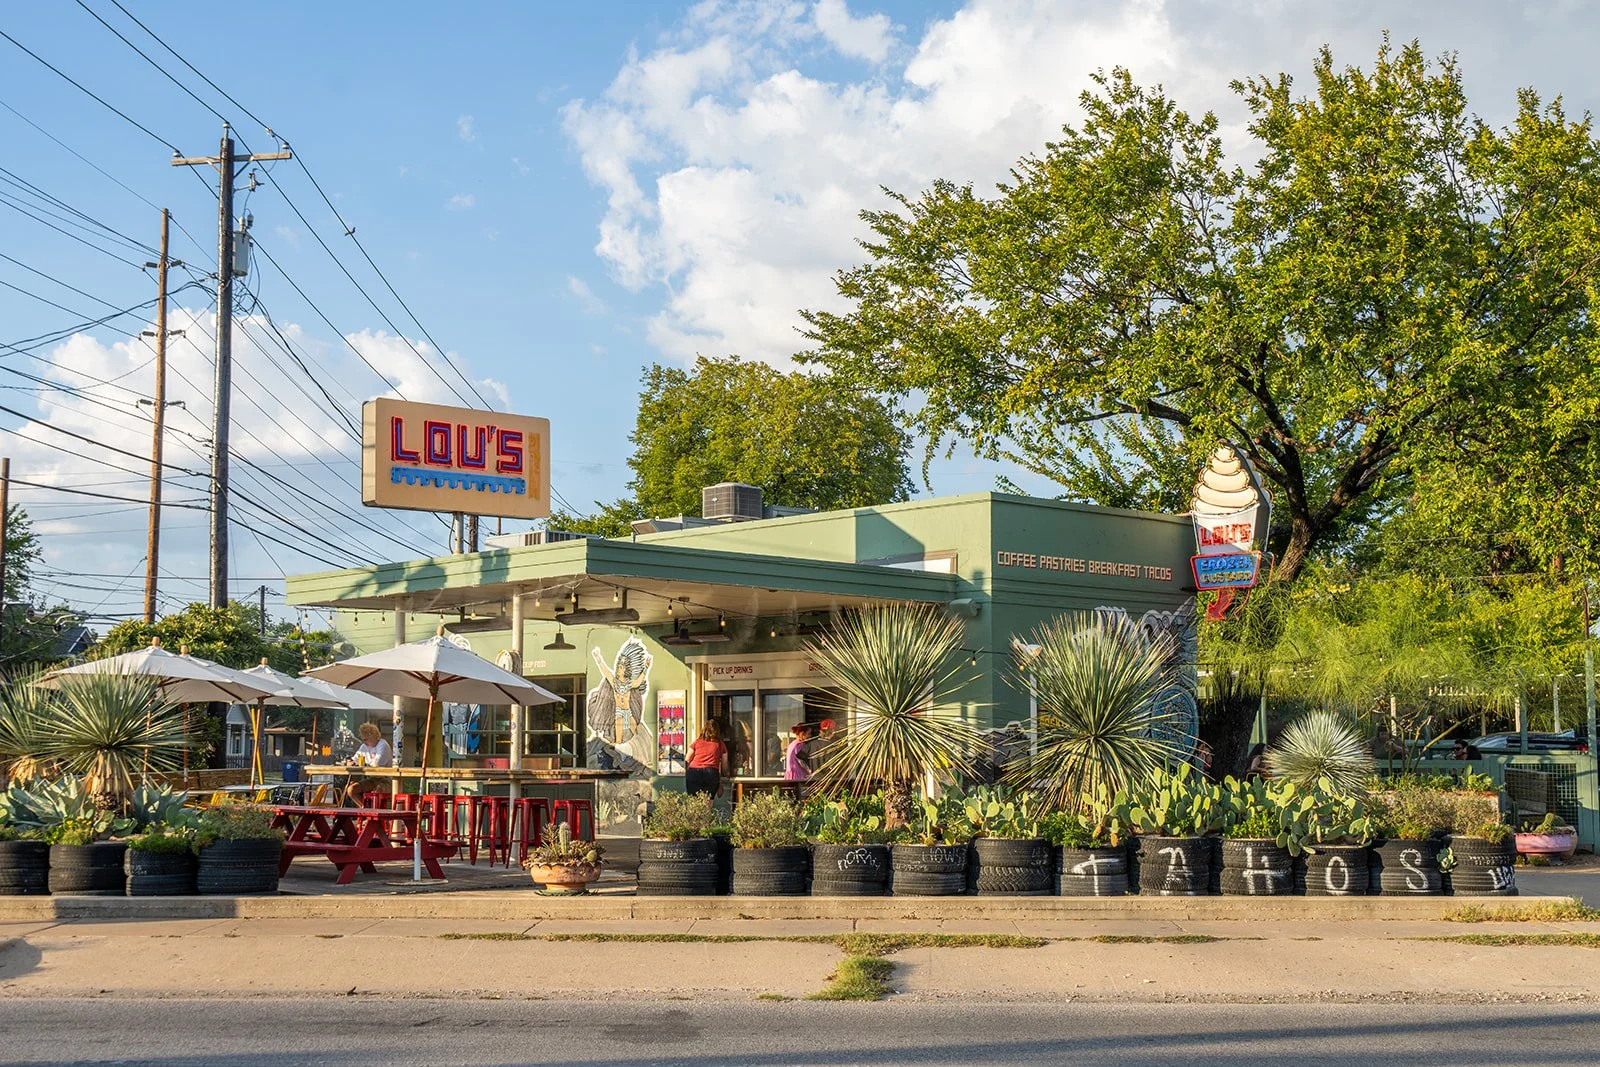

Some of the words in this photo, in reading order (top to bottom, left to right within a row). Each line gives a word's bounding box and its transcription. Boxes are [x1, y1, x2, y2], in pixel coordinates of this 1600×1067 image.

[391, 415, 524, 474] LOU'S
[1199, 523, 1252, 546] LOU'S
[997, 551, 1037, 568] COFFEE
[1039, 555, 1086, 573] PASTRIES
[1088, 560, 1142, 578] BREAKFAST
[1144, 565, 1172, 581] TACOS
[713, 666, 725, 675] PICK
[726, 666, 734, 674] UP
[734, 665, 753, 674] DRINKS
